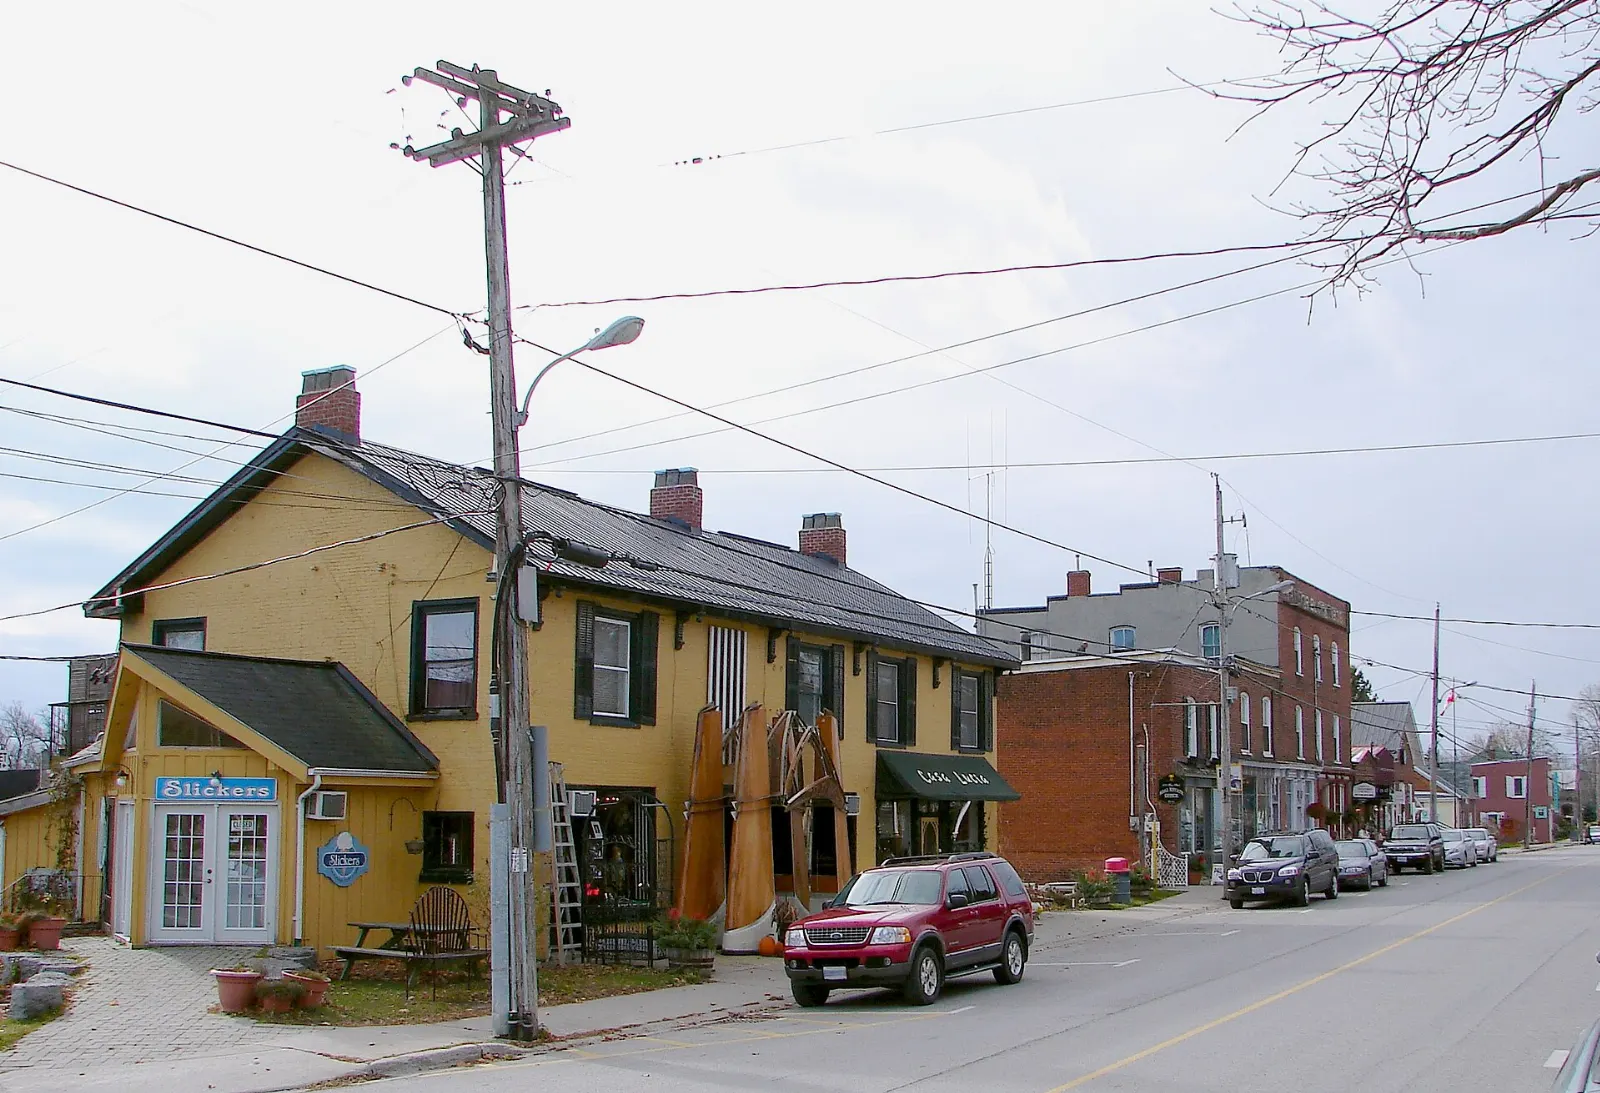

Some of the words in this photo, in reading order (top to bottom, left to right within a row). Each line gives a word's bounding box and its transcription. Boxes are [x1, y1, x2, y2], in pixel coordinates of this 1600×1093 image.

[917, 769, 951, 784] Casa
[953, 770, 990, 785] Lucia
[163, 779, 270, 797] Slickers
[329, 854, 361, 866] Slickers
